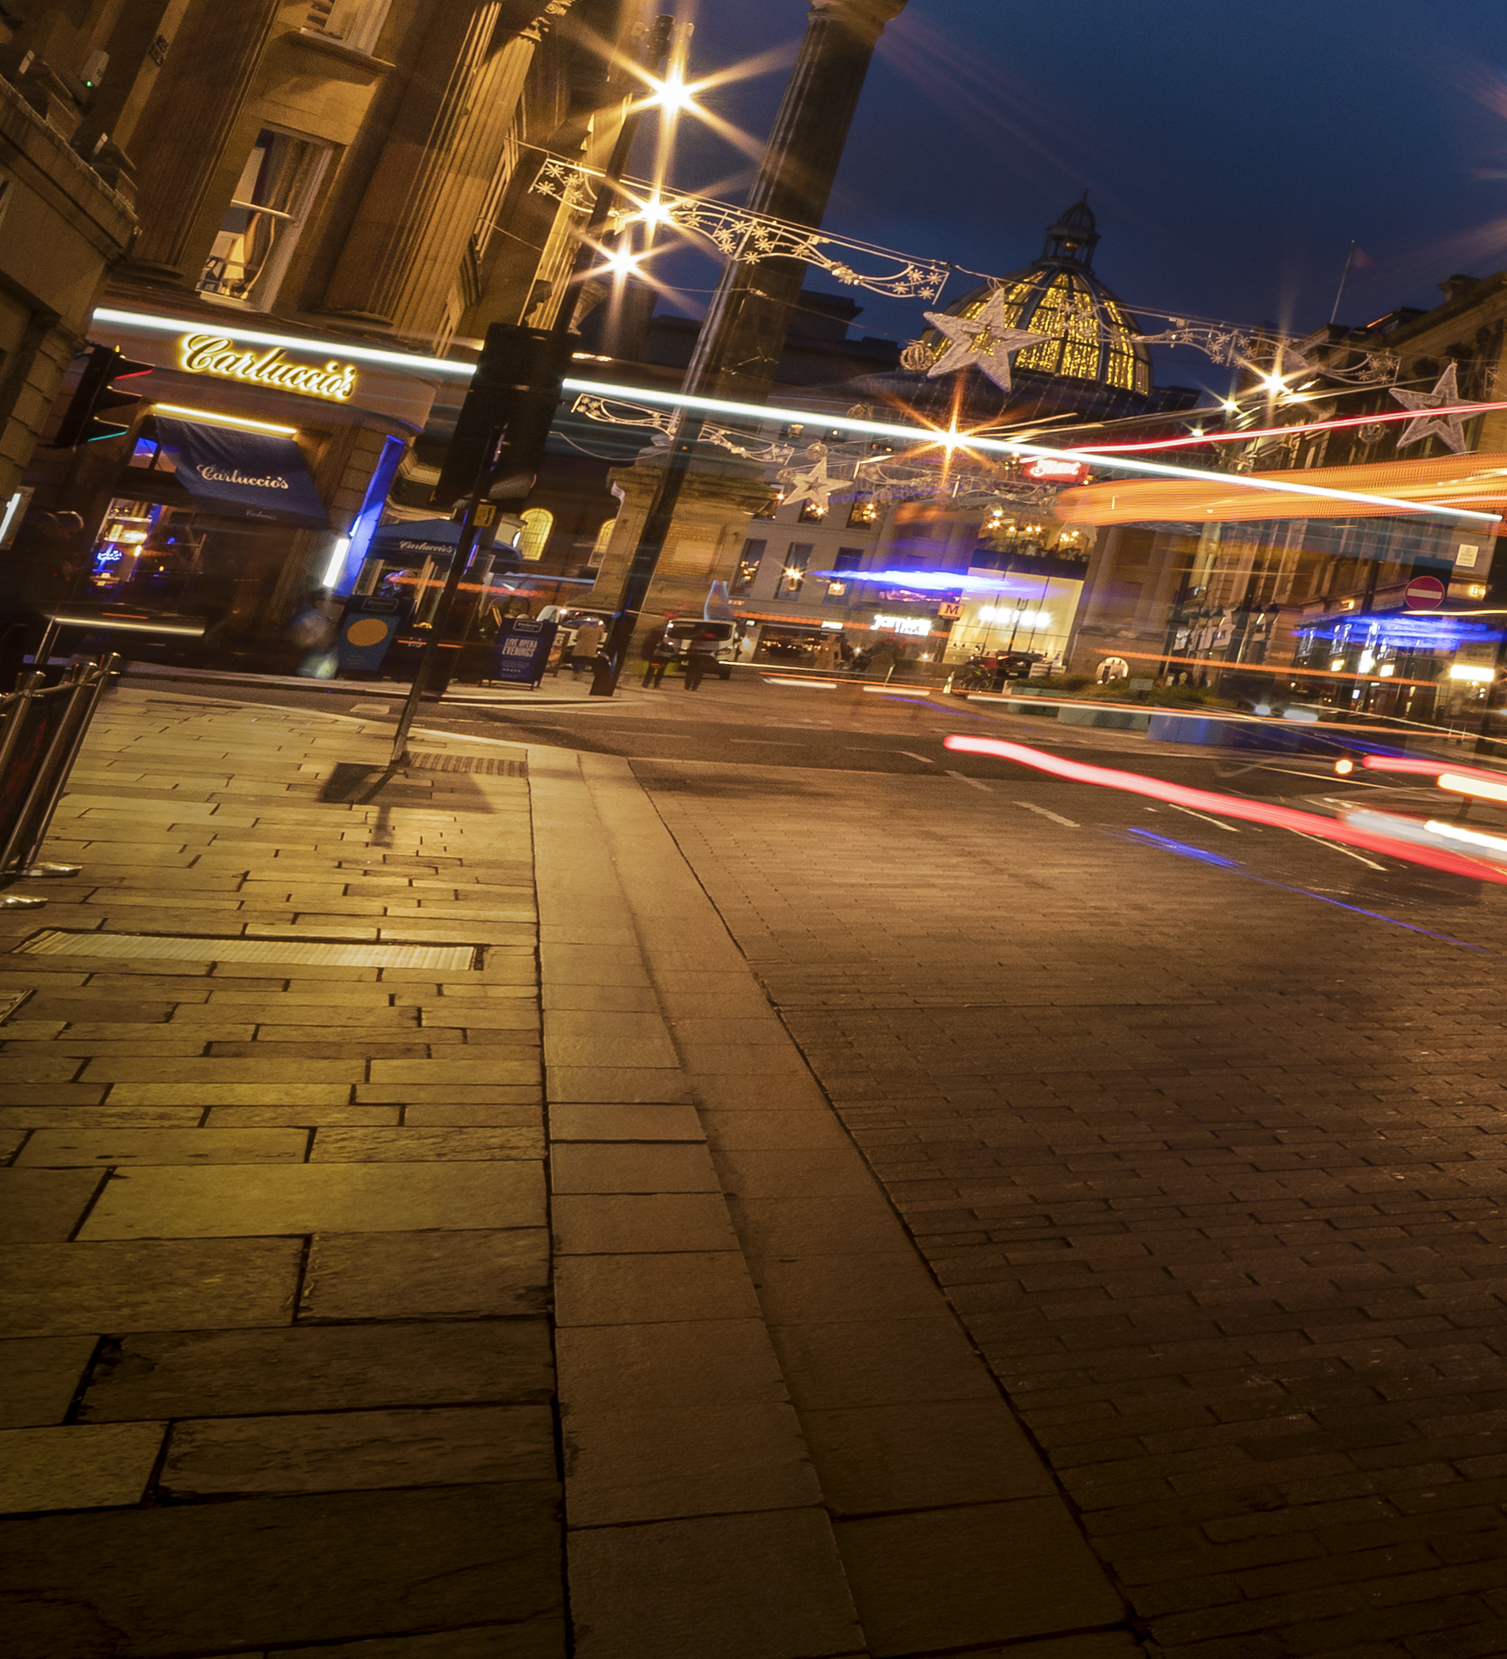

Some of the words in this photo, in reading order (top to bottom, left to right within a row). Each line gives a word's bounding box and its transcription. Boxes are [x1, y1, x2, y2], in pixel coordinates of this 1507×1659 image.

[182, 332, 357, 399] Carluccio's
[196, 464, 289, 489] Carluccio's
[944, 604, 960, 616] M
